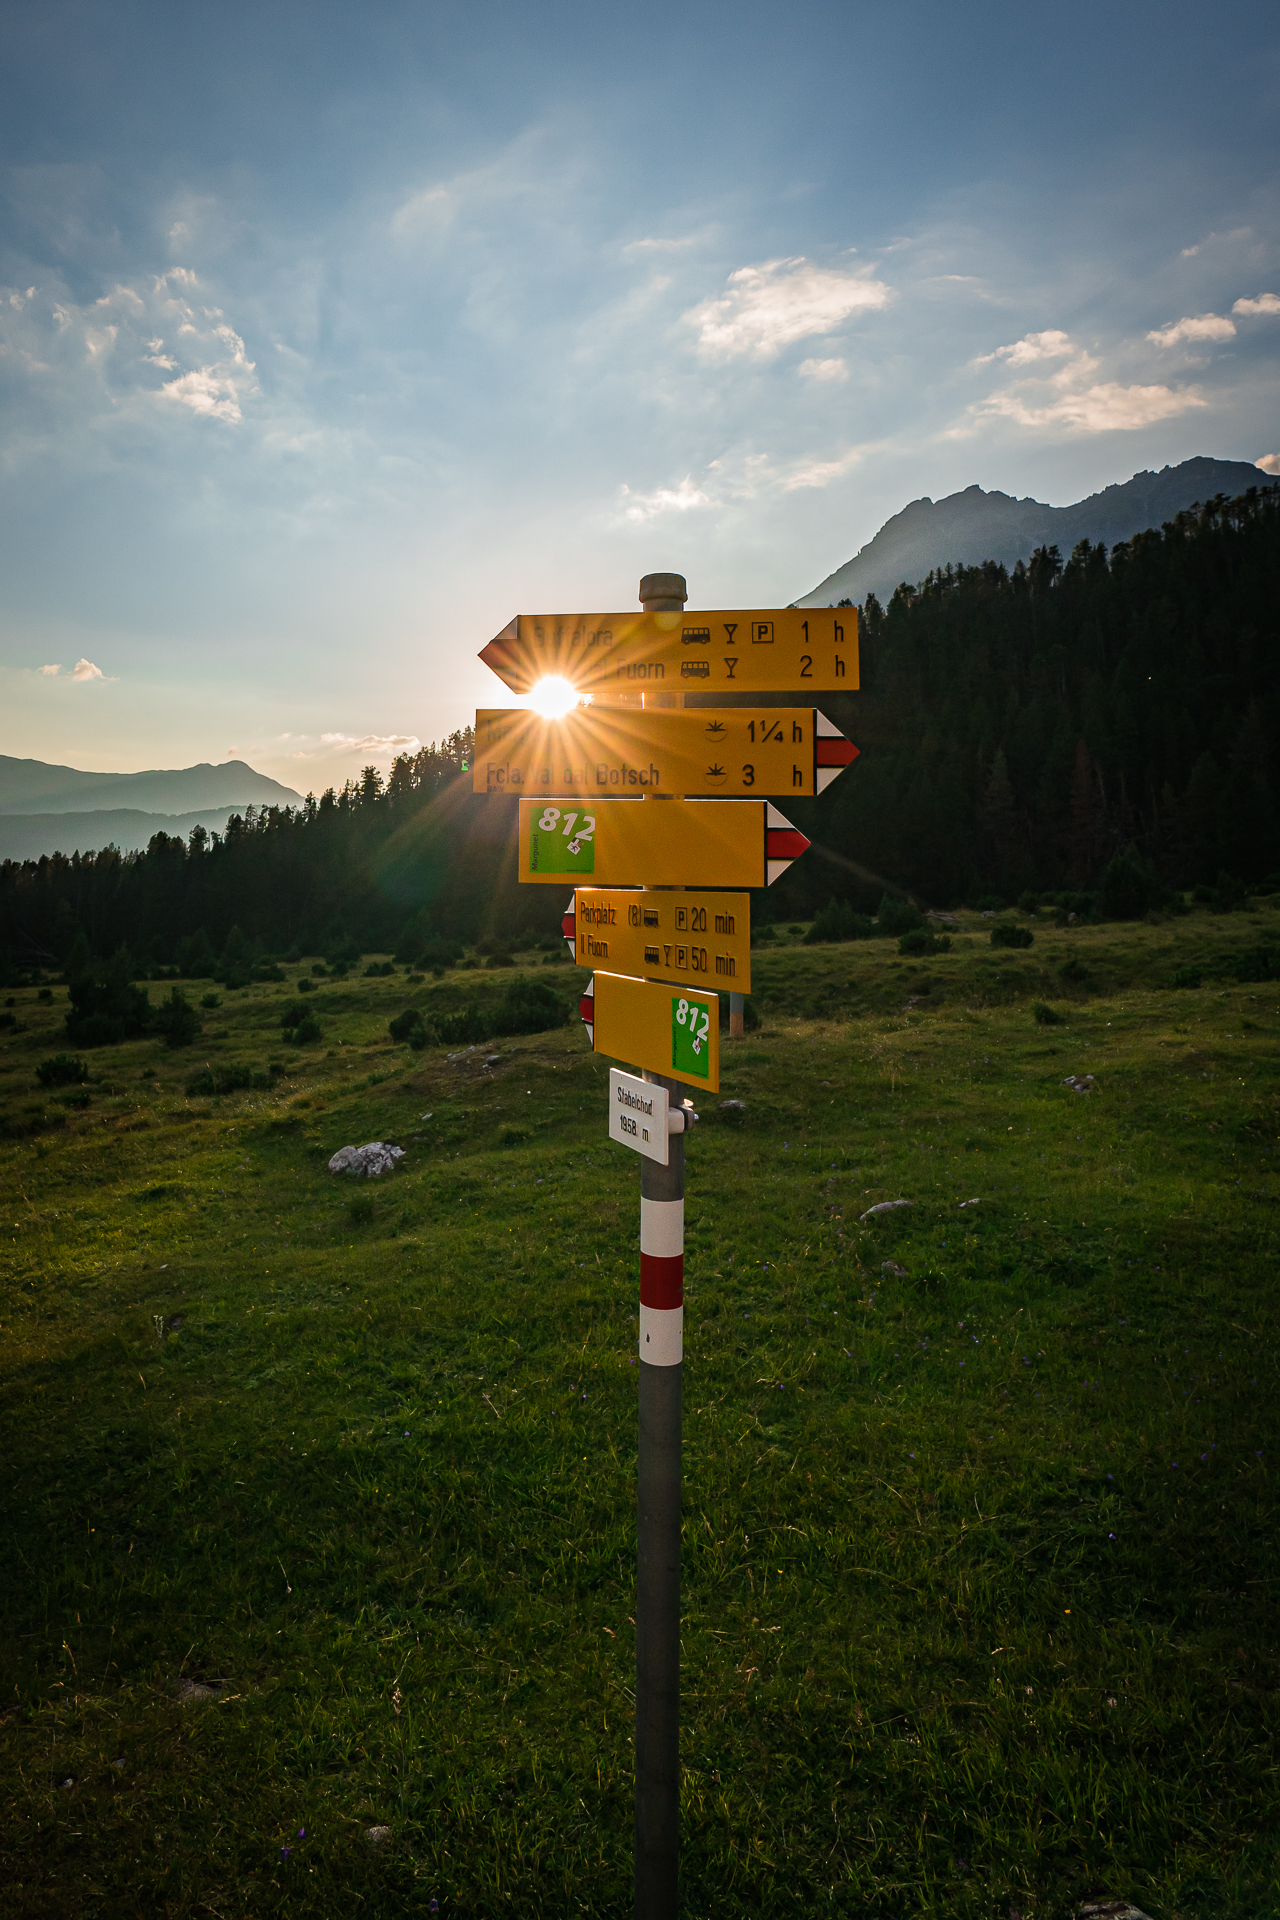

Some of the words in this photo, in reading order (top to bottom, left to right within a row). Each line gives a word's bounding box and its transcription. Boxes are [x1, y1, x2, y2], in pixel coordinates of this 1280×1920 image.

[801, 620, 809, 643] 1
[833, 620, 844, 642] h
[616, 657, 665, 680] Fuorn
[800, 655, 813, 677] 2
[835, 654, 845, 677] h
[792, 720, 803, 743] h
[596, 762, 660, 786] Botsch
[742, 764, 755, 786] 3
[792, 764, 803, 787] h
[538, 807, 596, 842] 812
[531, 833, 540, 871] Margunet
[580, 901, 617, 928] Parkplatz
[628, 904, 642, 927] (8)
[691, 906, 707, 932] 20
[715, 911, 735, 935] min
[587, 934, 609, 958] Fuorn
[691, 946, 707, 972] 50
[715, 952, 736, 977] min
[676, 998, 710, 1042] 812
[617, 1086, 653, 1116] Stabelchod
[620, 1114, 637, 1136] 1958
[642, 1128, 649, 1142] m
